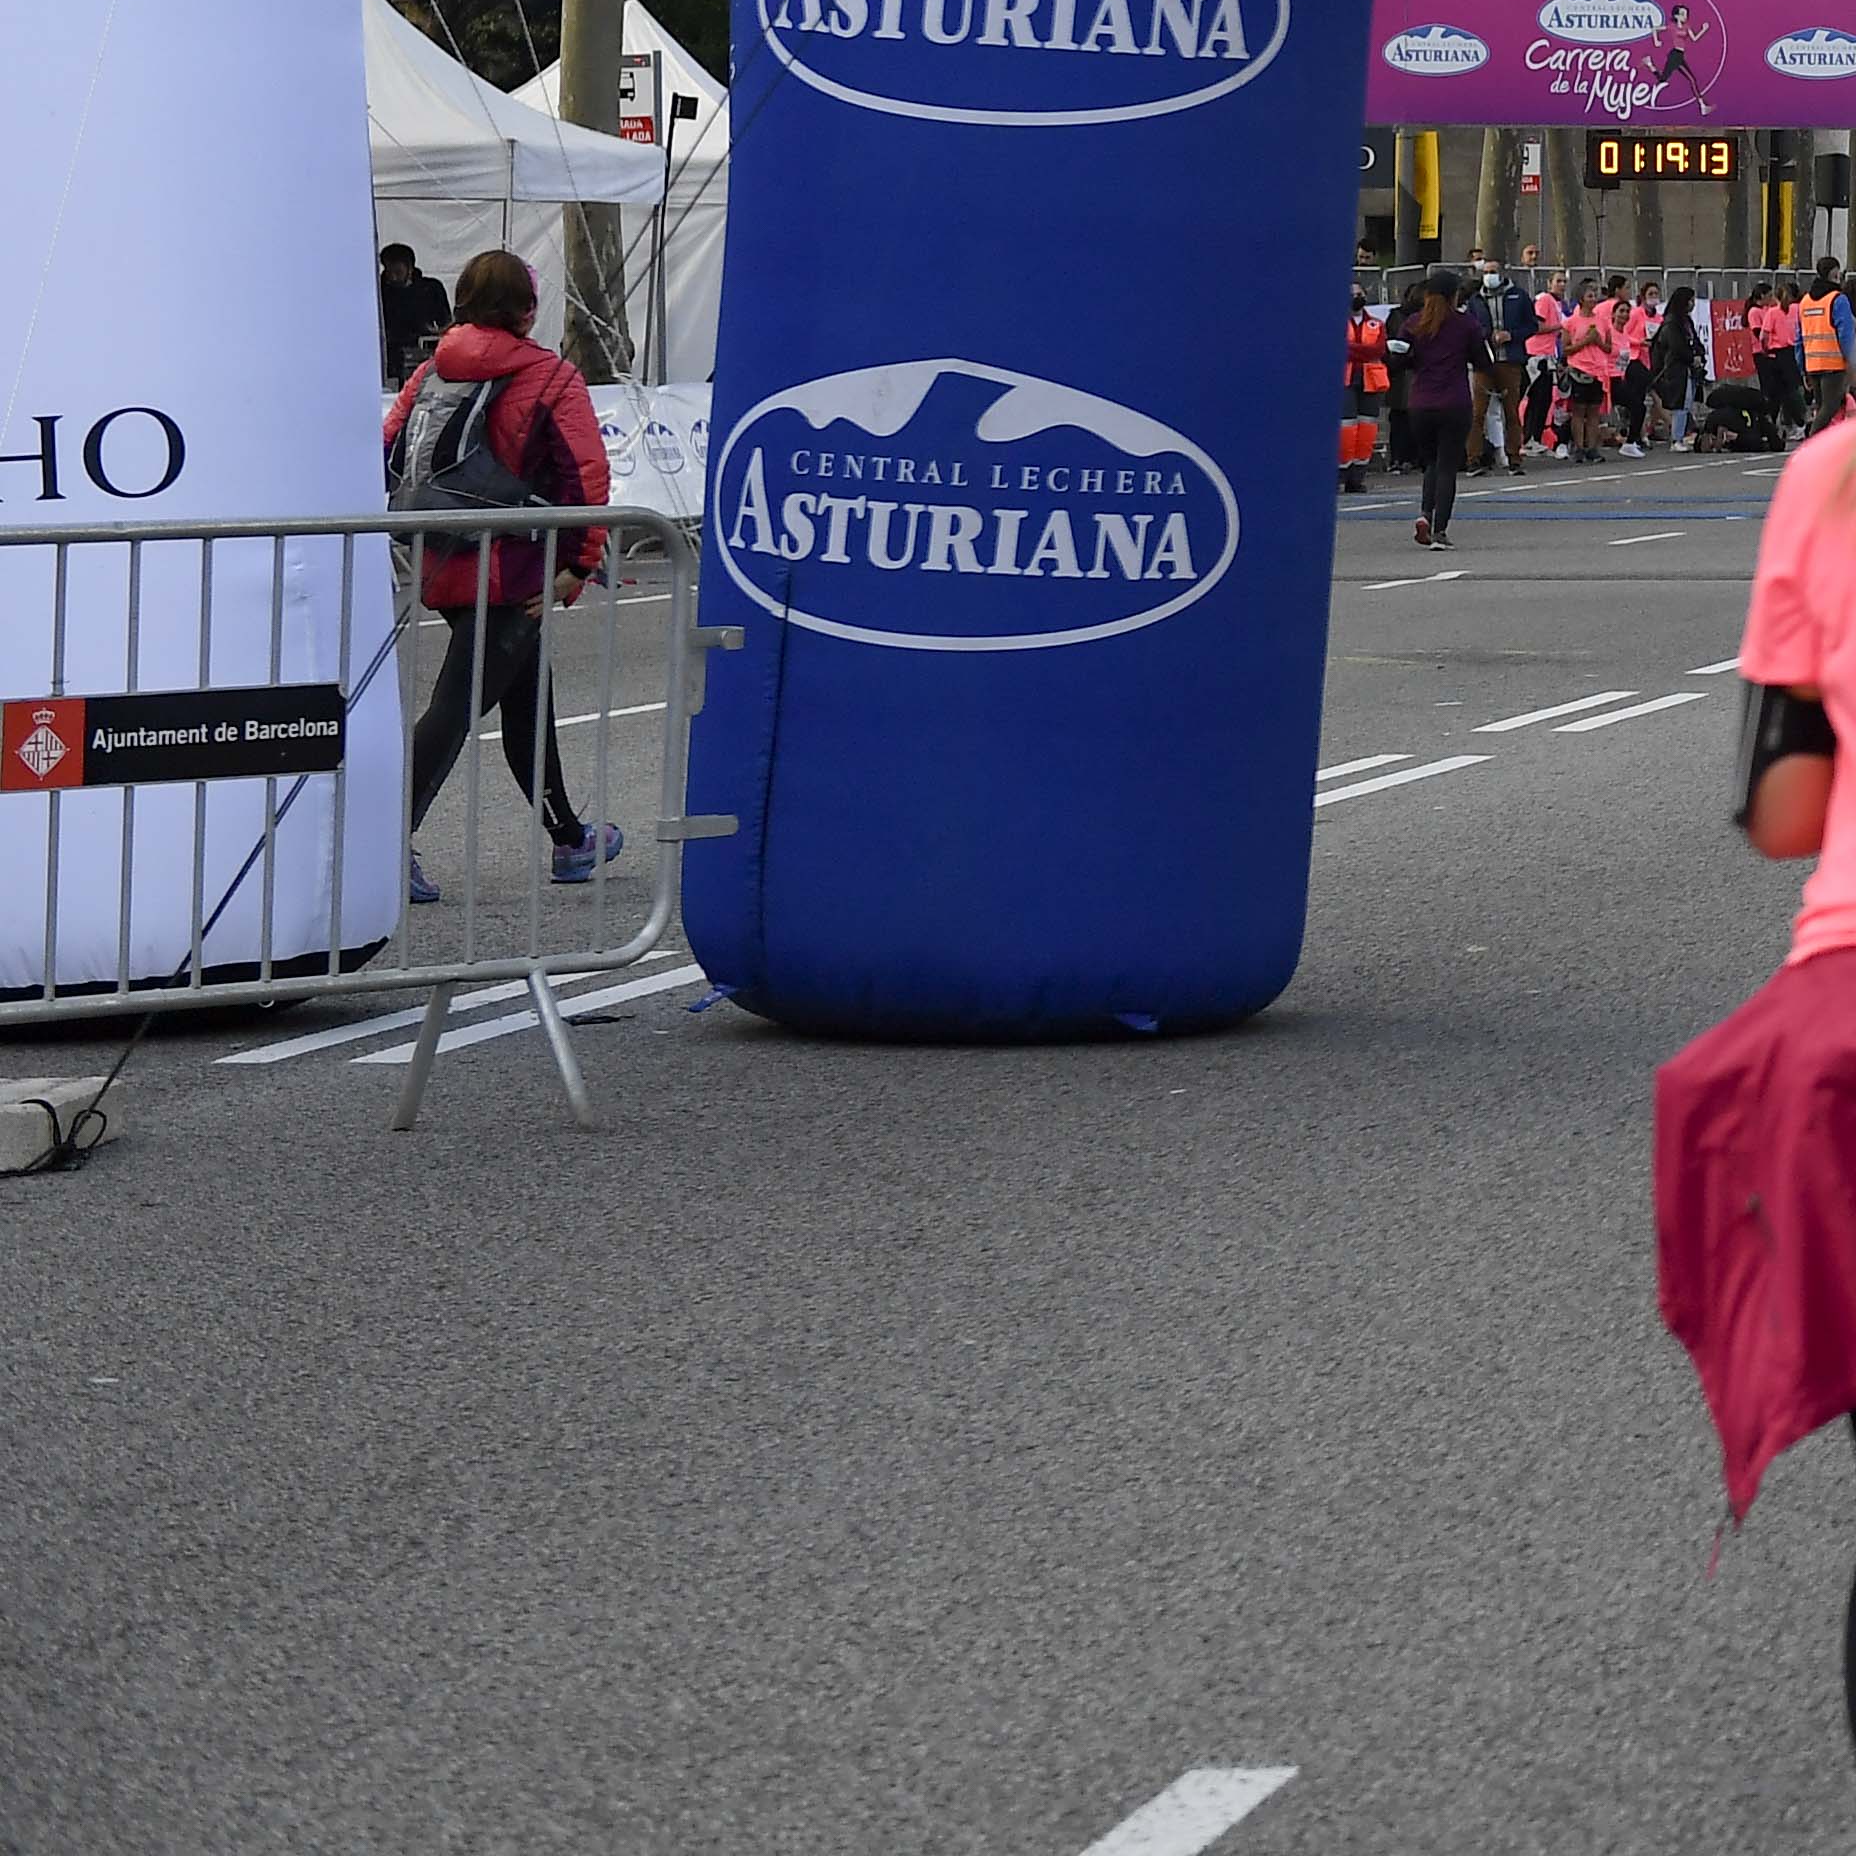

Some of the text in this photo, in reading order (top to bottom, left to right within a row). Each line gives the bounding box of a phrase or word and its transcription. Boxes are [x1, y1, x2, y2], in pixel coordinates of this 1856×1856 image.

[1547, 5, 1654, 29] ASTURIANA
[1391, 41, 1481, 64] ASTURIANA
[1524, 38, 1631, 72] Carrera
[1550, 71, 1588, 94] de la
[1585, 68, 1669, 120] Mujer
[790, 449, 1188, 498] CENTRAL LECHERA
[727, 446, 1199, 582] ASTURIANA
[92, 716, 340, 754] Ajuntament de Barcelona
